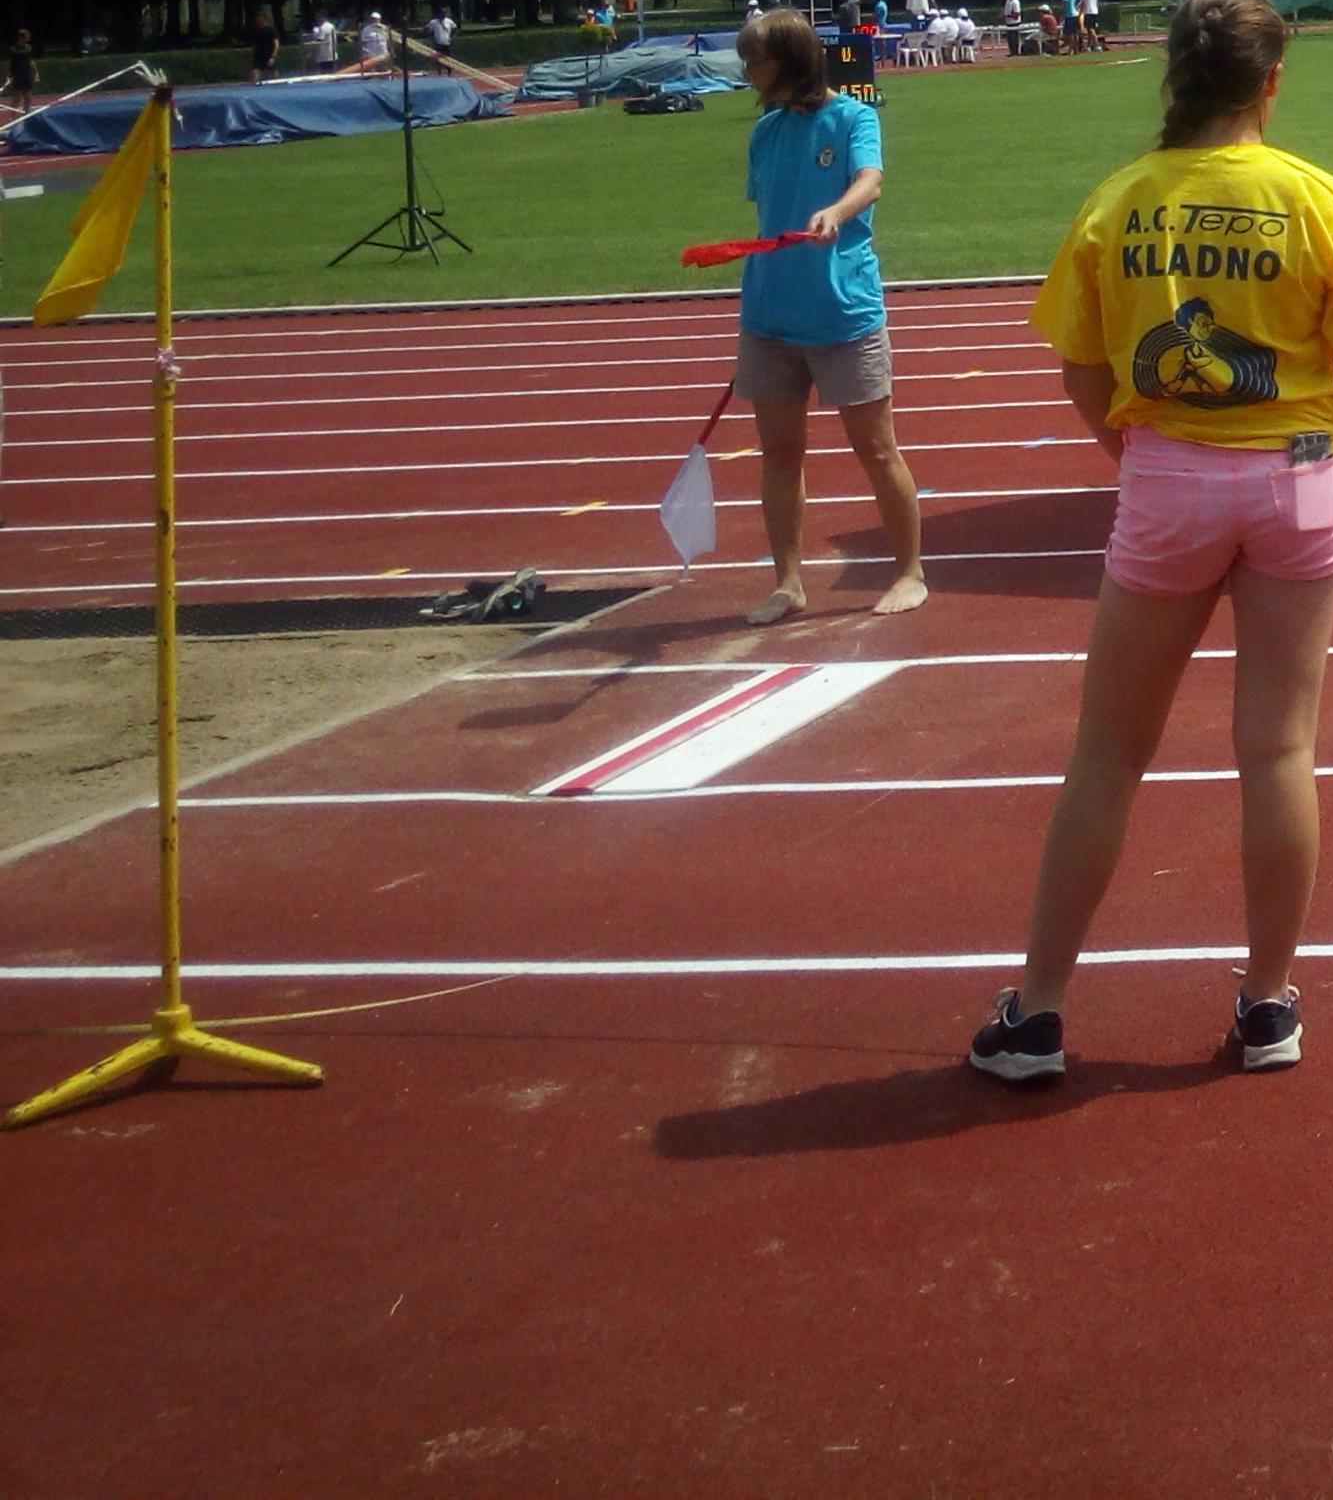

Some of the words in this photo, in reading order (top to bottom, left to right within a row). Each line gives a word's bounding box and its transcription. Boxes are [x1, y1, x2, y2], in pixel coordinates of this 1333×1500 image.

[1125, 205, 1176, 235] A.C.
[1180, 204, 1291, 237] Tepo
[1122, 243, 1281, 282] KLADNO
